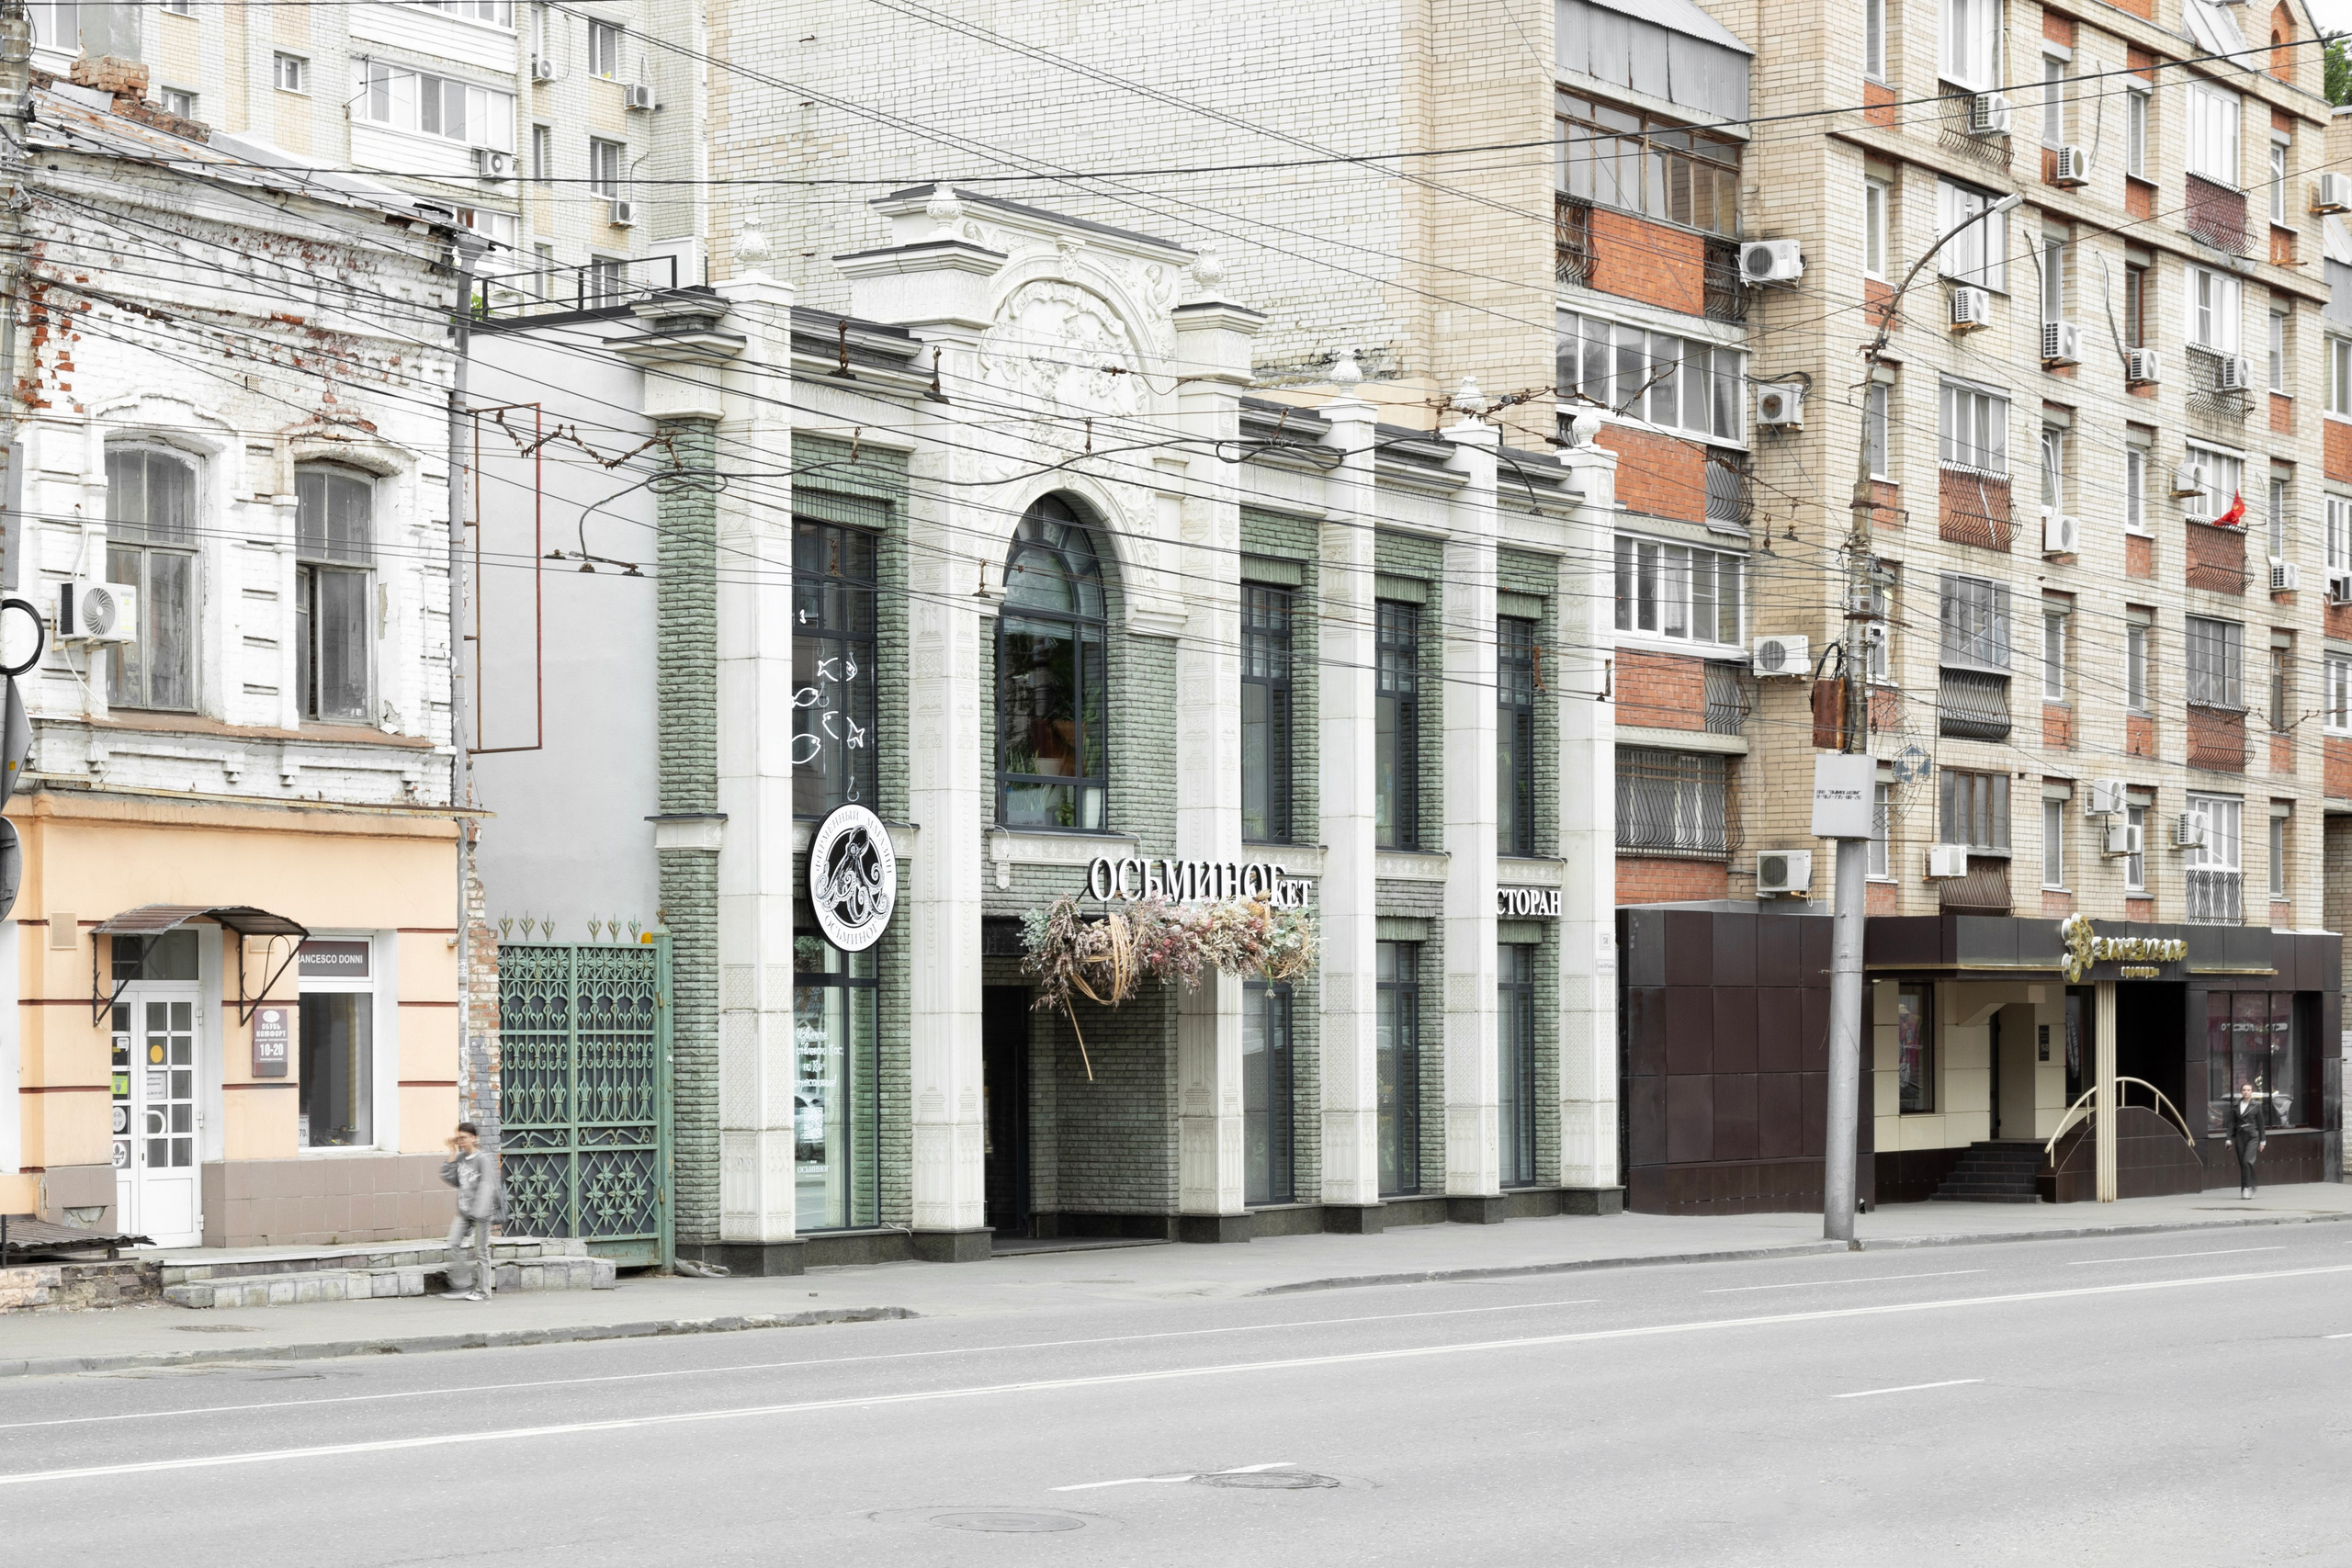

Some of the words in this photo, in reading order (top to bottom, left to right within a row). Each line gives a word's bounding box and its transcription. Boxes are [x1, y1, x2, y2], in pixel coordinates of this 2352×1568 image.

[816, 809, 860, 872] ФИРМЕННЫЙ
[865, 817, 893, 874] МАГАЗИН
[1088, 855, 1287, 907] ОСЬМИНОГ
[824, 915, 878, 945] ОСЬМИНОГ
[338, 953, 363, 964] DONNI
[2095, 937, 2188, 962] ЗАНЗИБАР
[255, 1030, 287, 1038] КОМФОРТ
[259, 1043, 284, 1056] 10-20
[797, 1165, 831, 1174] ОСЬМИНОГ
